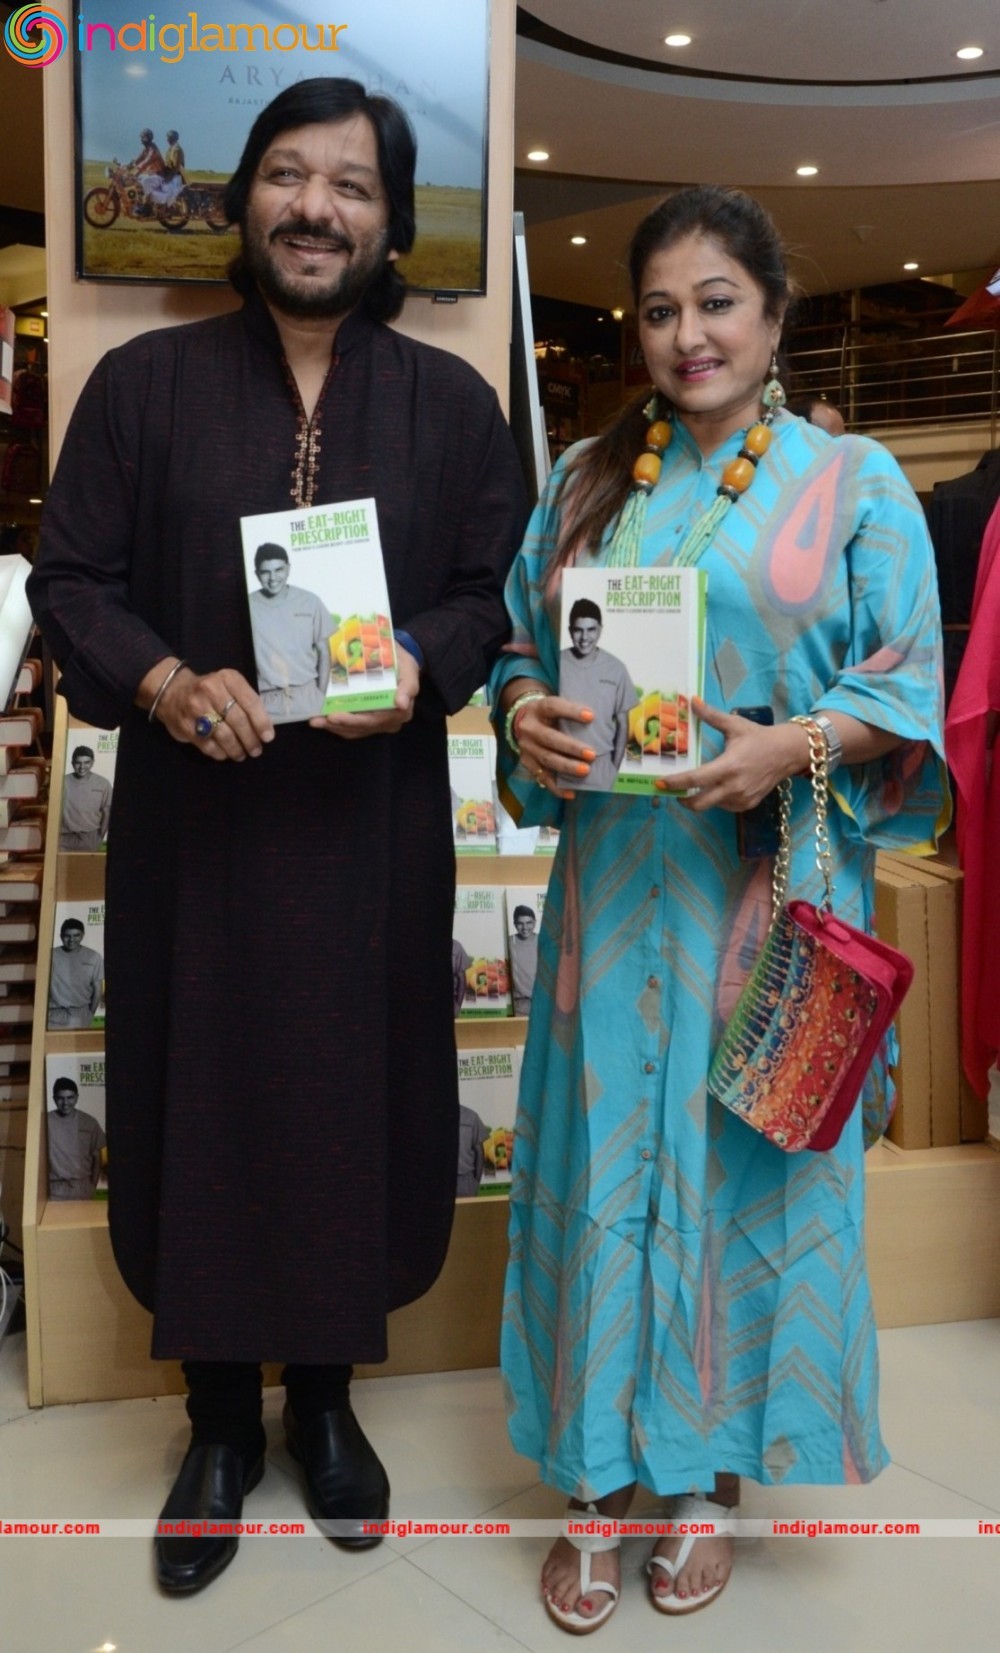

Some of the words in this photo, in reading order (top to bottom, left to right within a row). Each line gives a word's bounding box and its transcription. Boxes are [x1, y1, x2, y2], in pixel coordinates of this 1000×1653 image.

[290, 520, 306, 532] THE
[307, 508, 366, 529] EAT-RIGHT
[290, 523, 369, 547] PRESCRIPTION
[608, 579, 622, 591] THE
[625, 575, 681, 591] EAT-RIGHT
[606, 591, 681, 607] PRESCRIPTION
[458, 1059, 469, 1067] THE
[470, 1053, 512, 1066] EAT-RIGHT
[80, 1064, 91, 1073] THE
[458, 1063, 513, 1077] PRESCRIPTION
